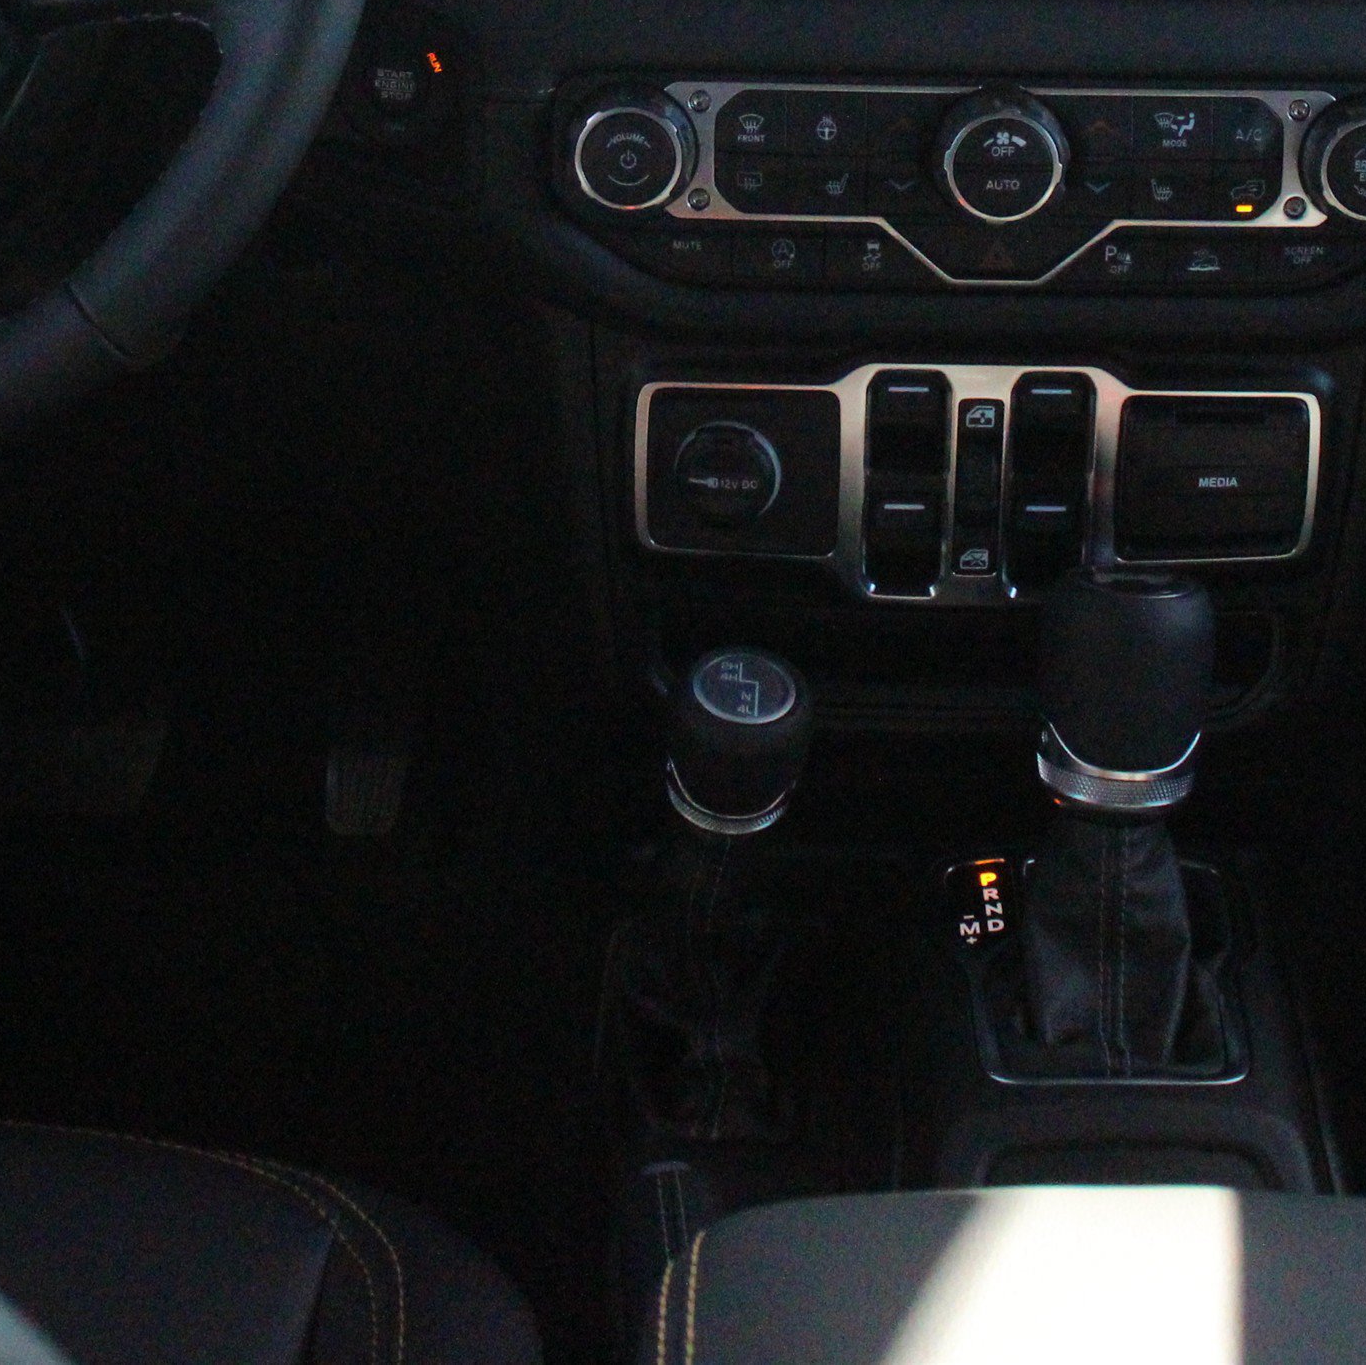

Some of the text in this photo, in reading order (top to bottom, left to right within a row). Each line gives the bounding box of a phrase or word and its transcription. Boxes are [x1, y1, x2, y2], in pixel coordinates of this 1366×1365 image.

[426, 52, 444, 74] RUN
[737, 135, 765, 143] FRONT
[1235, 129, 1262, 142] A/C
[1162, 139, 1188, 147] MODE
[991, 146, 1016, 157] OFF
[985, 180, 1020, 190] AUTO
[674, 241, 702, 250] MUTE
[1284, 246, 1325, 255] SCREEN
[1293, 256, 1312, 265] OFF
[1198, 477, 1238, 488] MEDIA
[979, 872, 997, 887] P
[982, 888, 1000, 901] R
[985, 902, 1003, 916] N
[959, 921, 981, 936] M
[987, 919, 1005, 932] D
